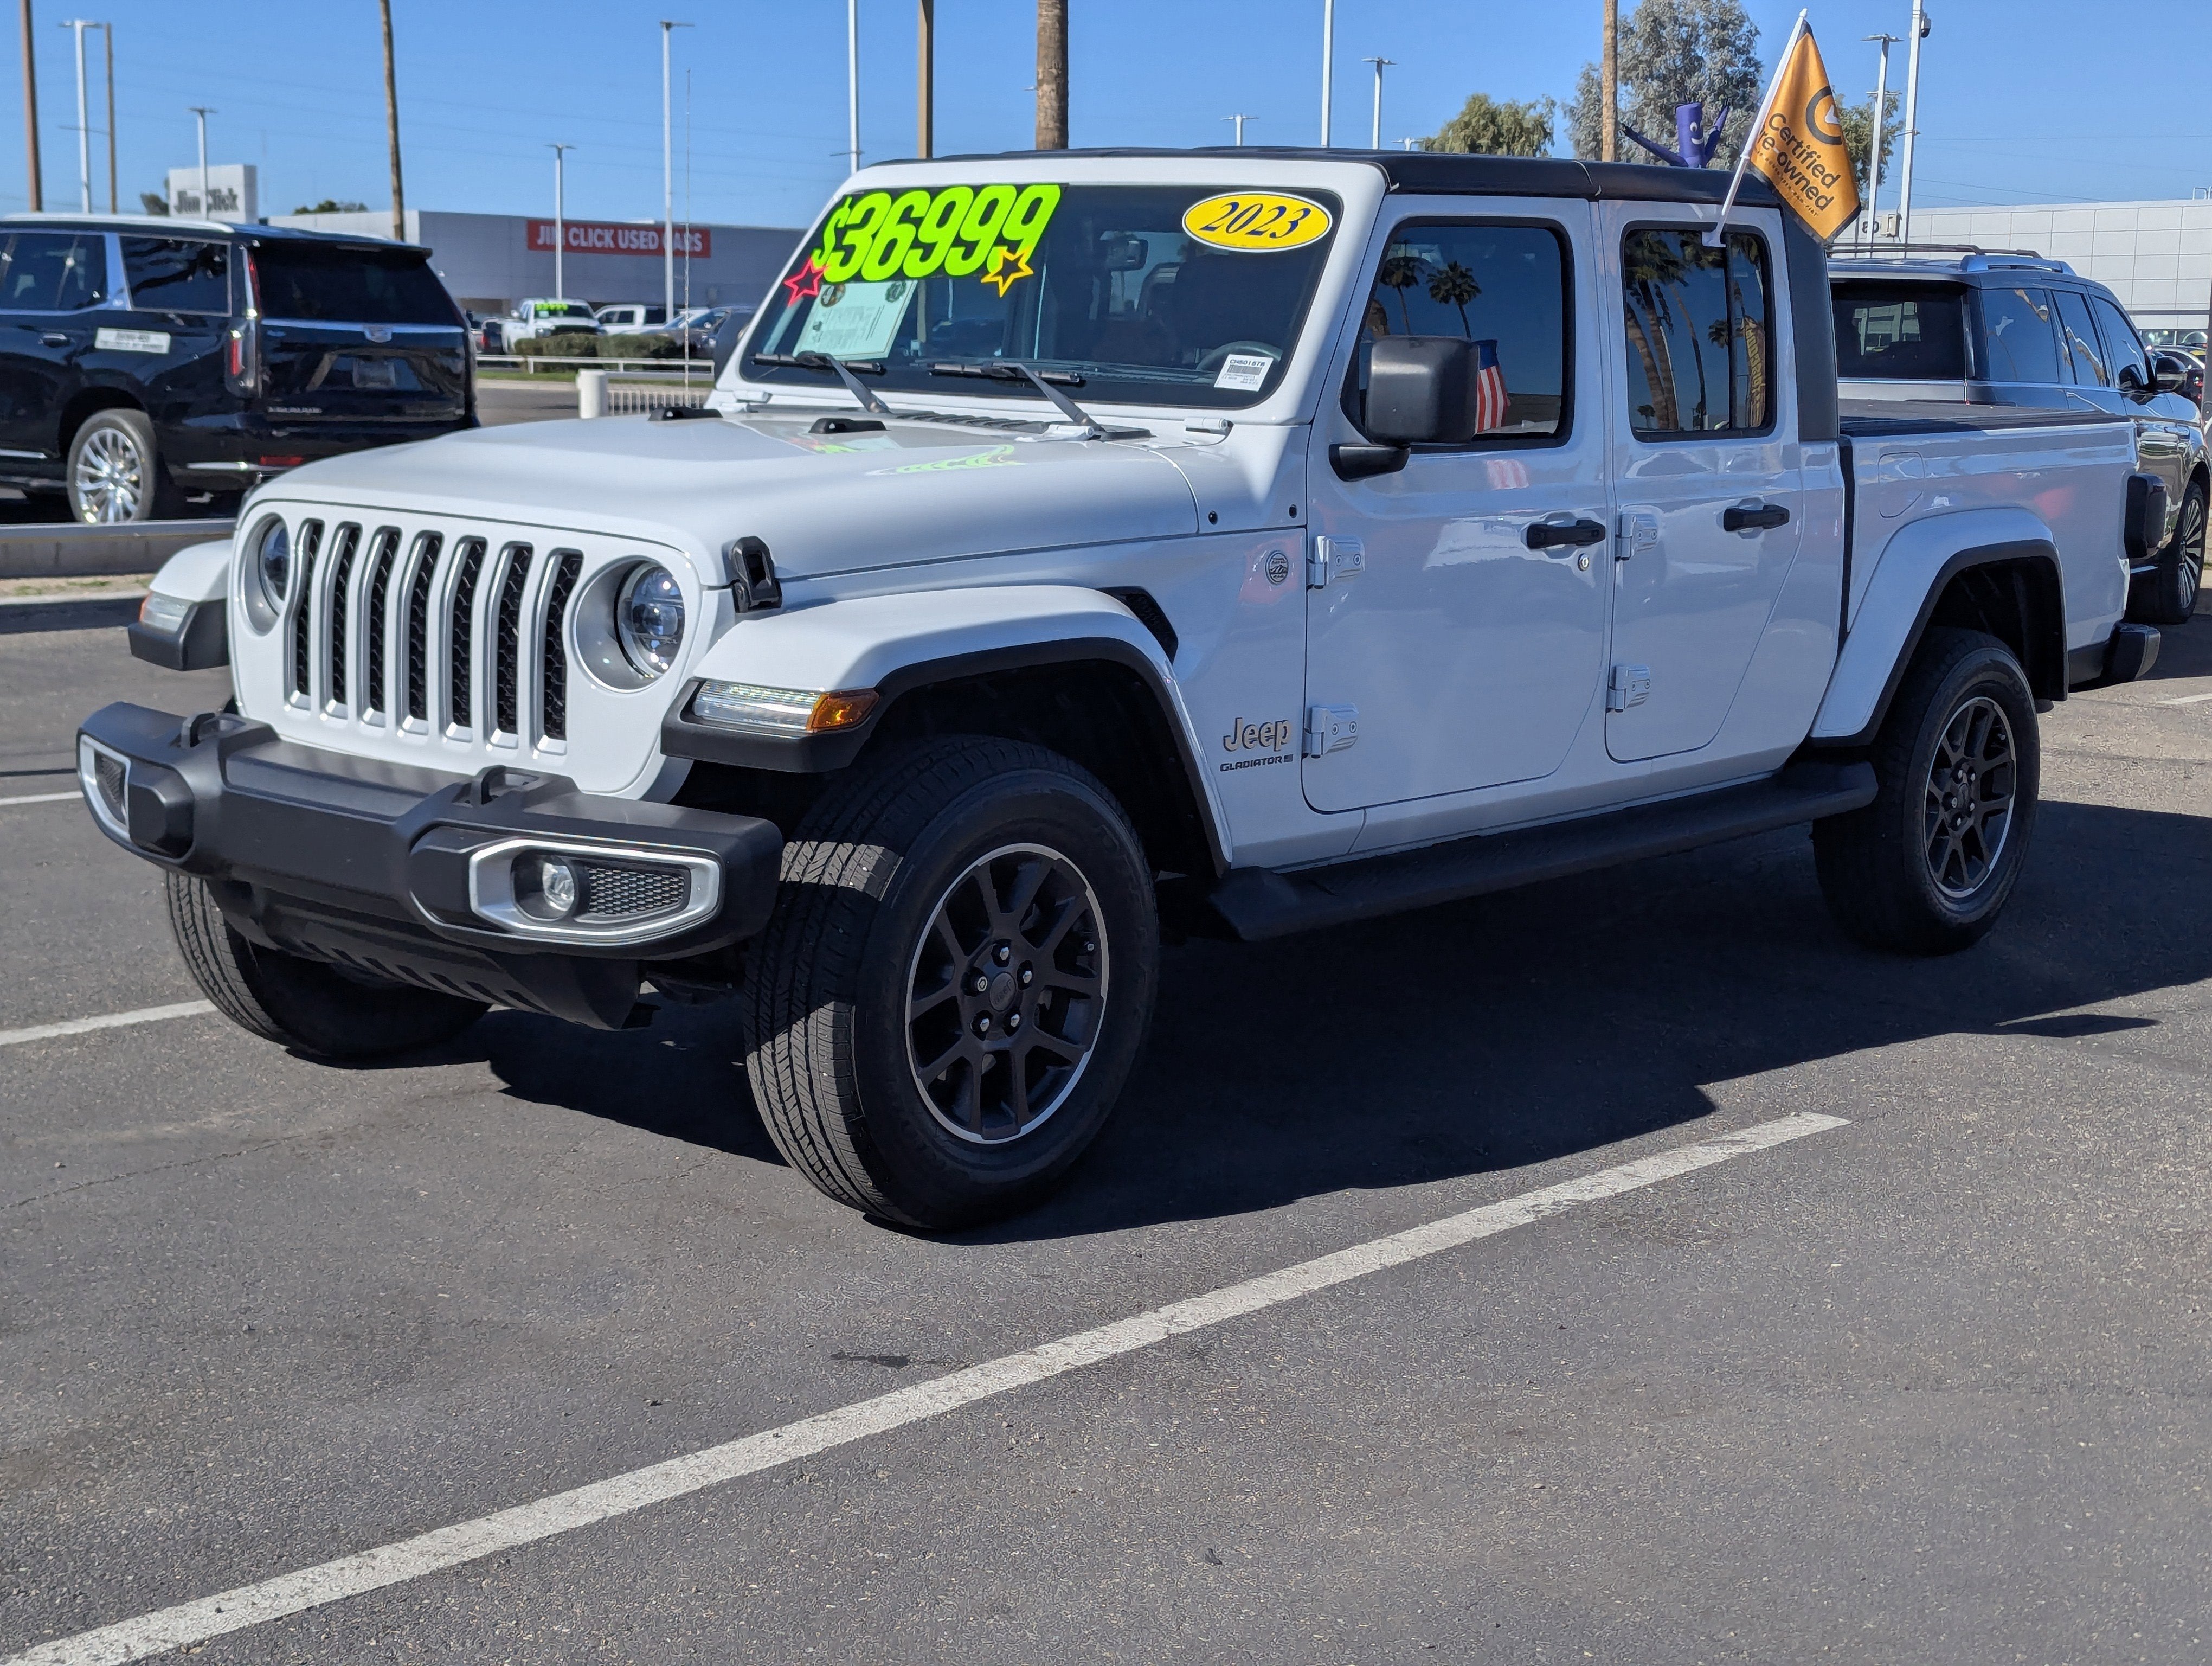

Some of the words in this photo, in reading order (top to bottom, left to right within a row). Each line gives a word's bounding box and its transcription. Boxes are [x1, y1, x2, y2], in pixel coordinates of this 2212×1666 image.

[1757, 124, 1835, 211] re-owned
[1769, 113, 1841, 189] Certified
[569, 227, 615, 248] CLICK
[618, 229, 659, 250] USED
[811, 184, 1061, 282] $36999
[1198, 202, 1311, 239] 2023
[1223, 717, 1291, 752] Jeep
[1220, 755, 1282, 772] GLADIATOR
